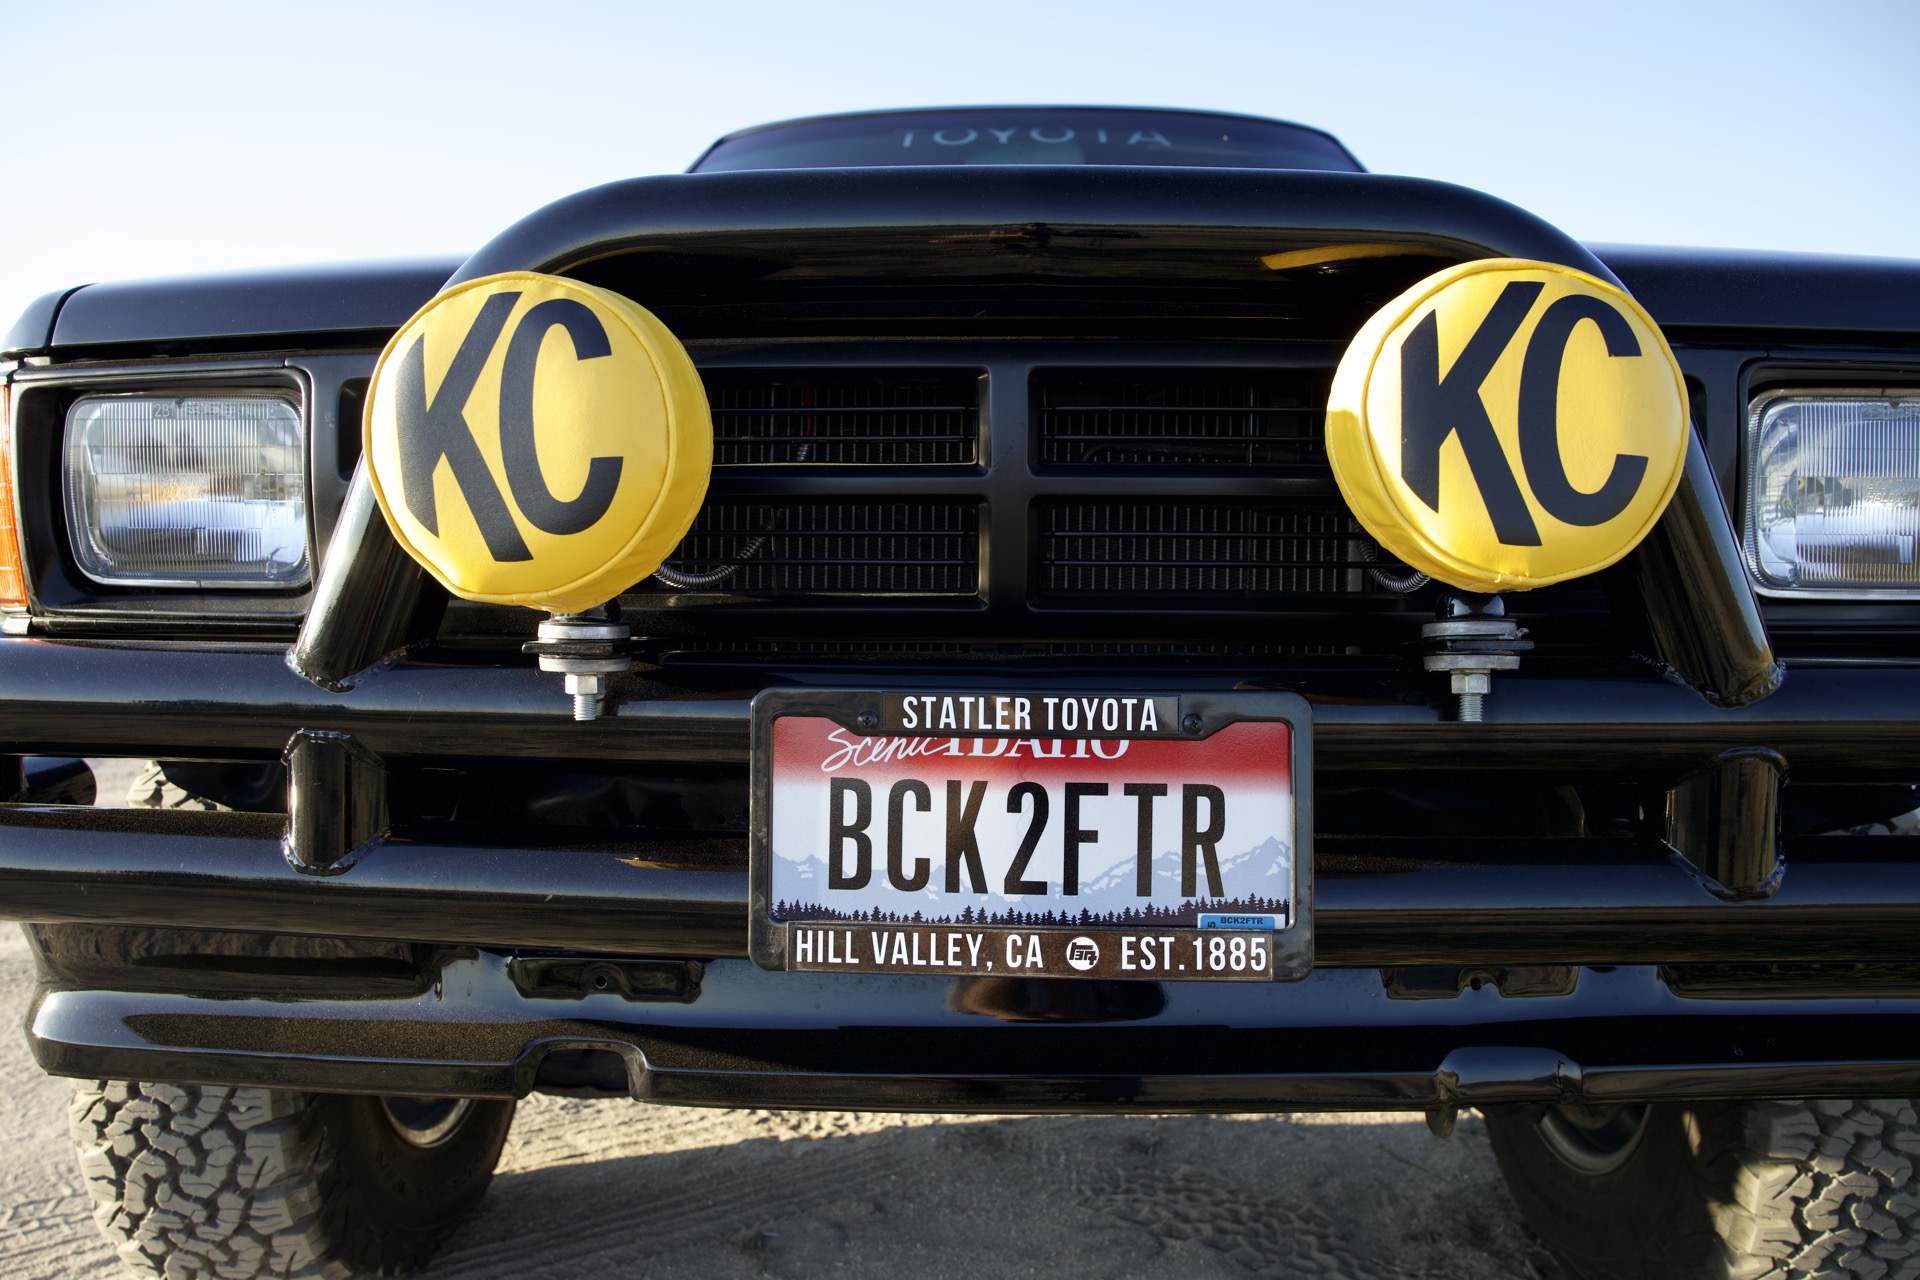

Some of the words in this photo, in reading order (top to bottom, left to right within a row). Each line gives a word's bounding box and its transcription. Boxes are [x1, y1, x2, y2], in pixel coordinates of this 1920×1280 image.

[395, 291, 624, 562] KC
[1400, 281, 1649, 546] KC
[902, 696, 1031, 730] STATLER
[1043, 697, 1158, 732] TOYOTA
[828, 776, 1226, 898] BCK2FTR
[796, 929, 860, 965] HILL
[871, 931, 994, 972] VALLEY,
[1005, 934, 1044, 968] CA
[1220, 916, 1264, 925] BCK2FTR
